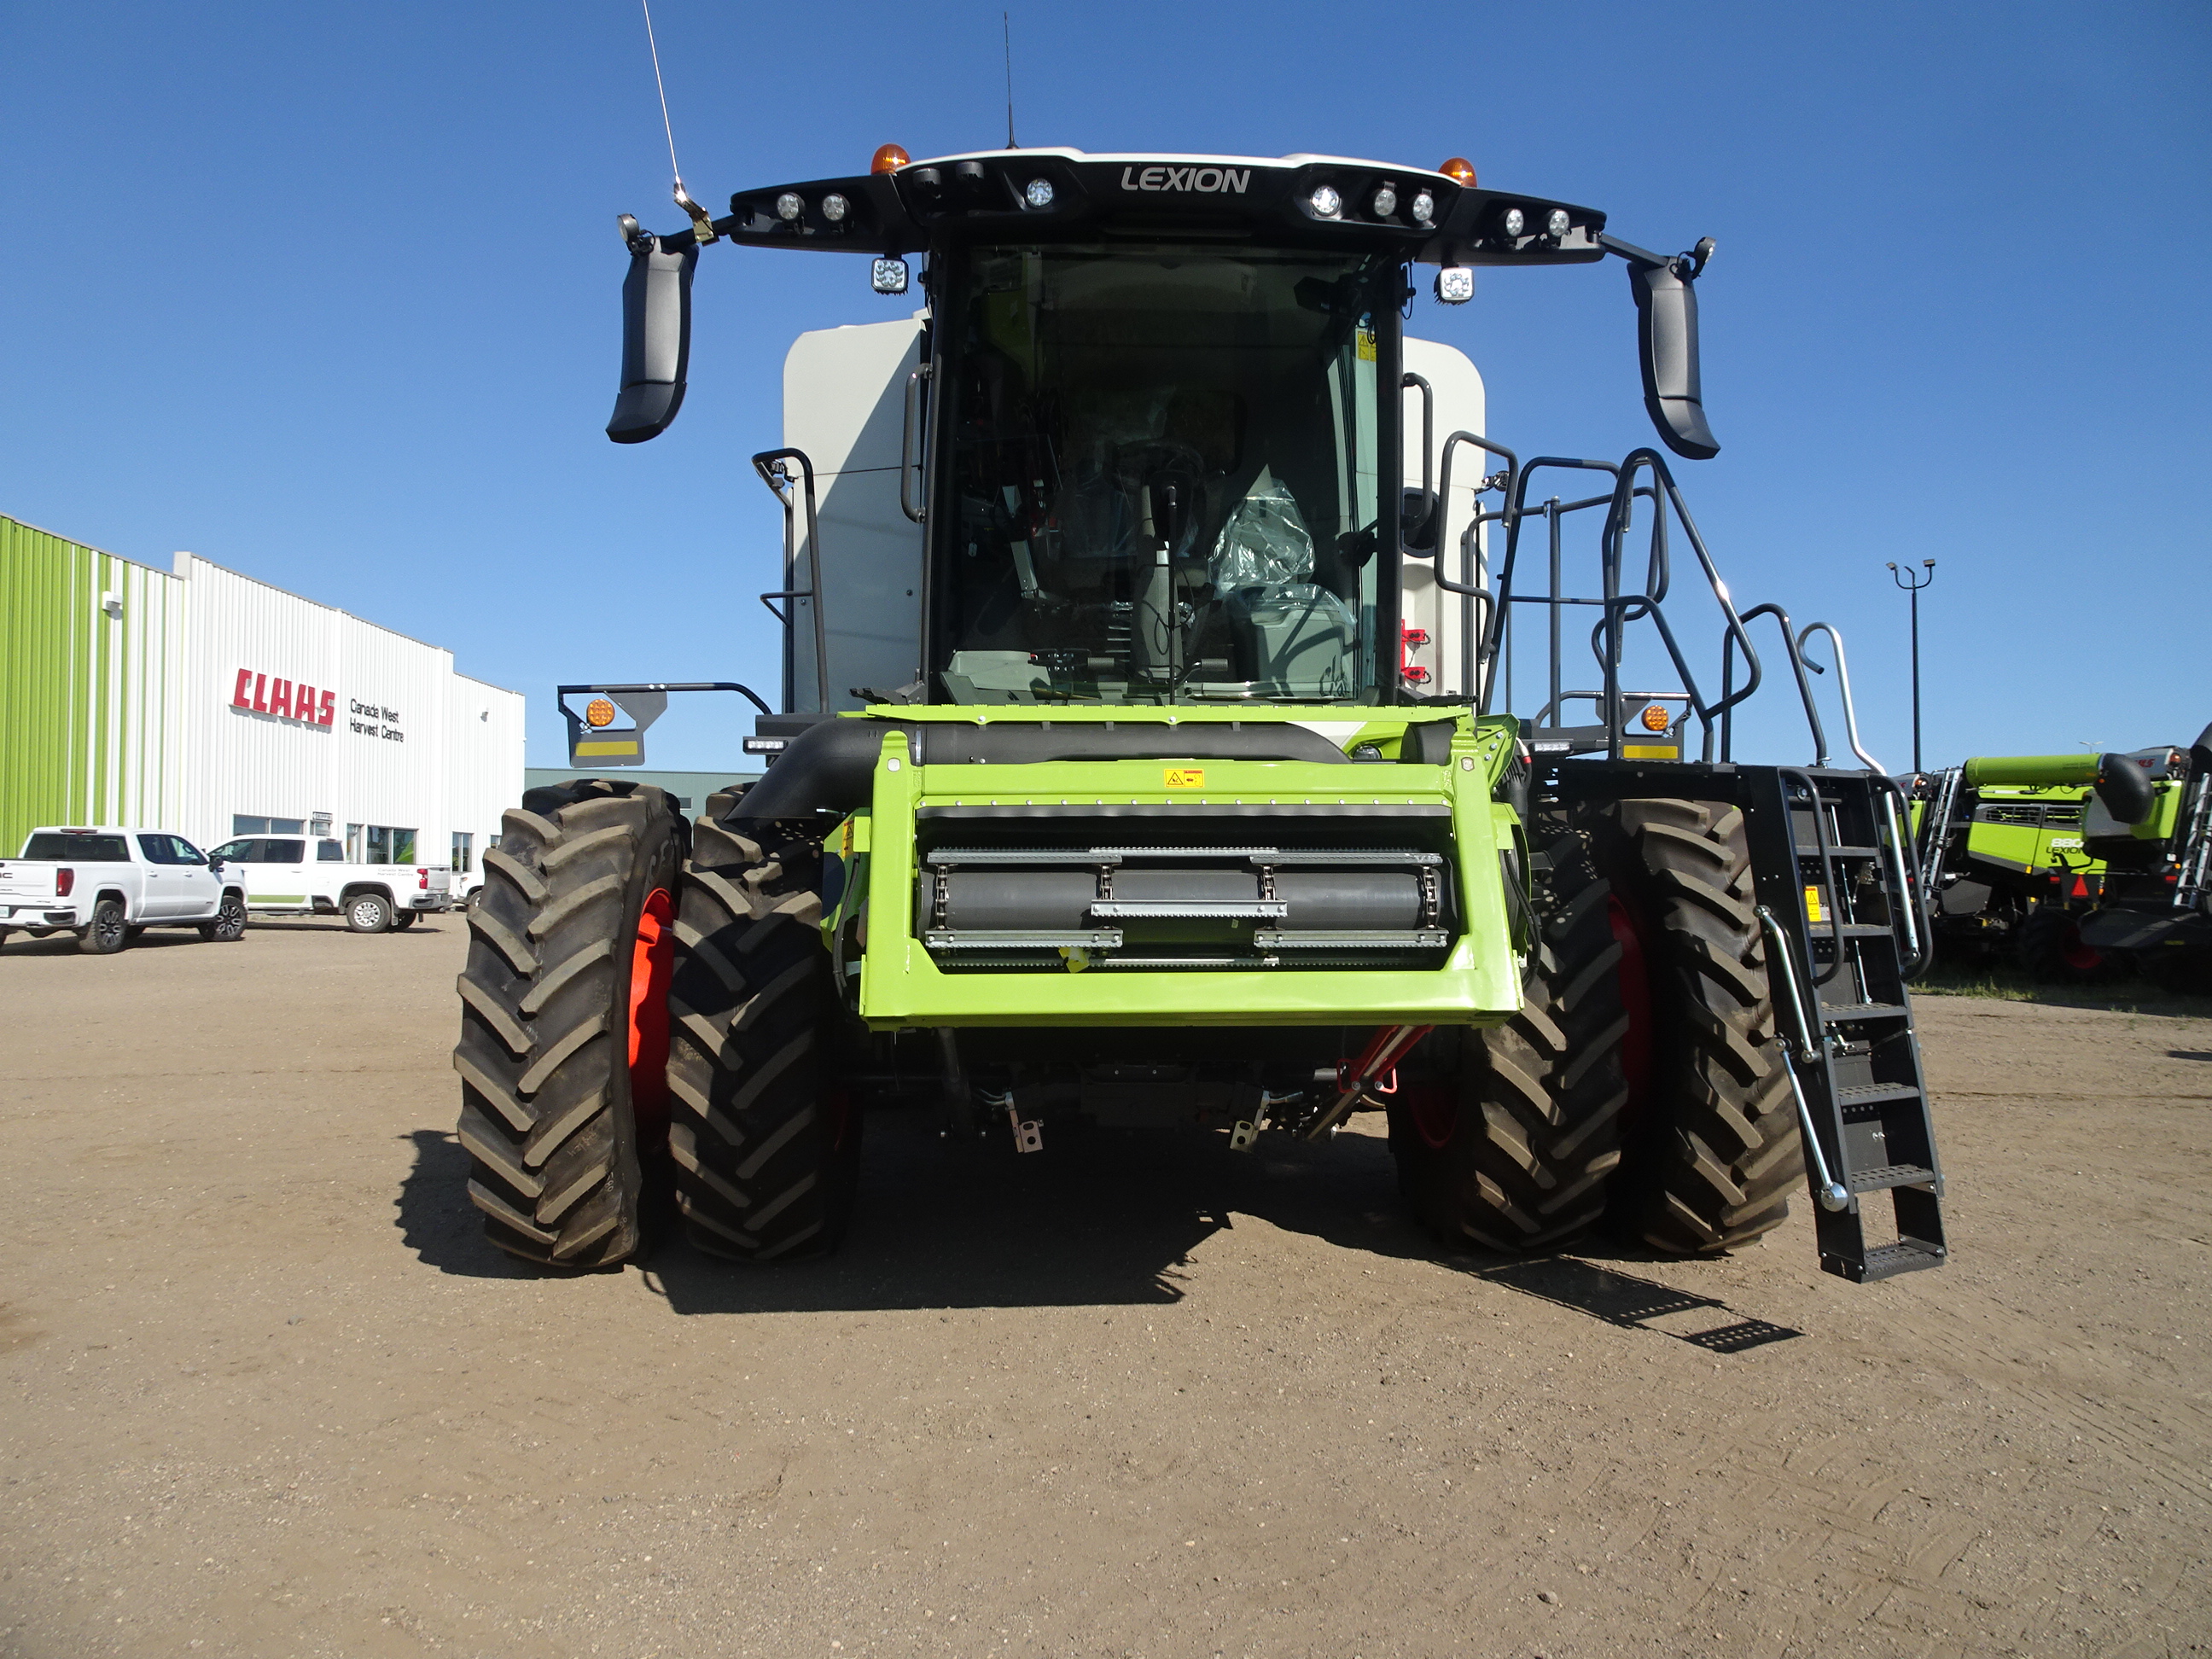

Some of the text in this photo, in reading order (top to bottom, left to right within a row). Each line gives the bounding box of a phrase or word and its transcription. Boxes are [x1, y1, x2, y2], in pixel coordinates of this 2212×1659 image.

[1121, 166, 1251, 194] LEXION
[233, 667, 335, 726] CLAAS
[350, 698, 399, 724] Canada West
[350, 718, 405, 743] Harvest Centre
